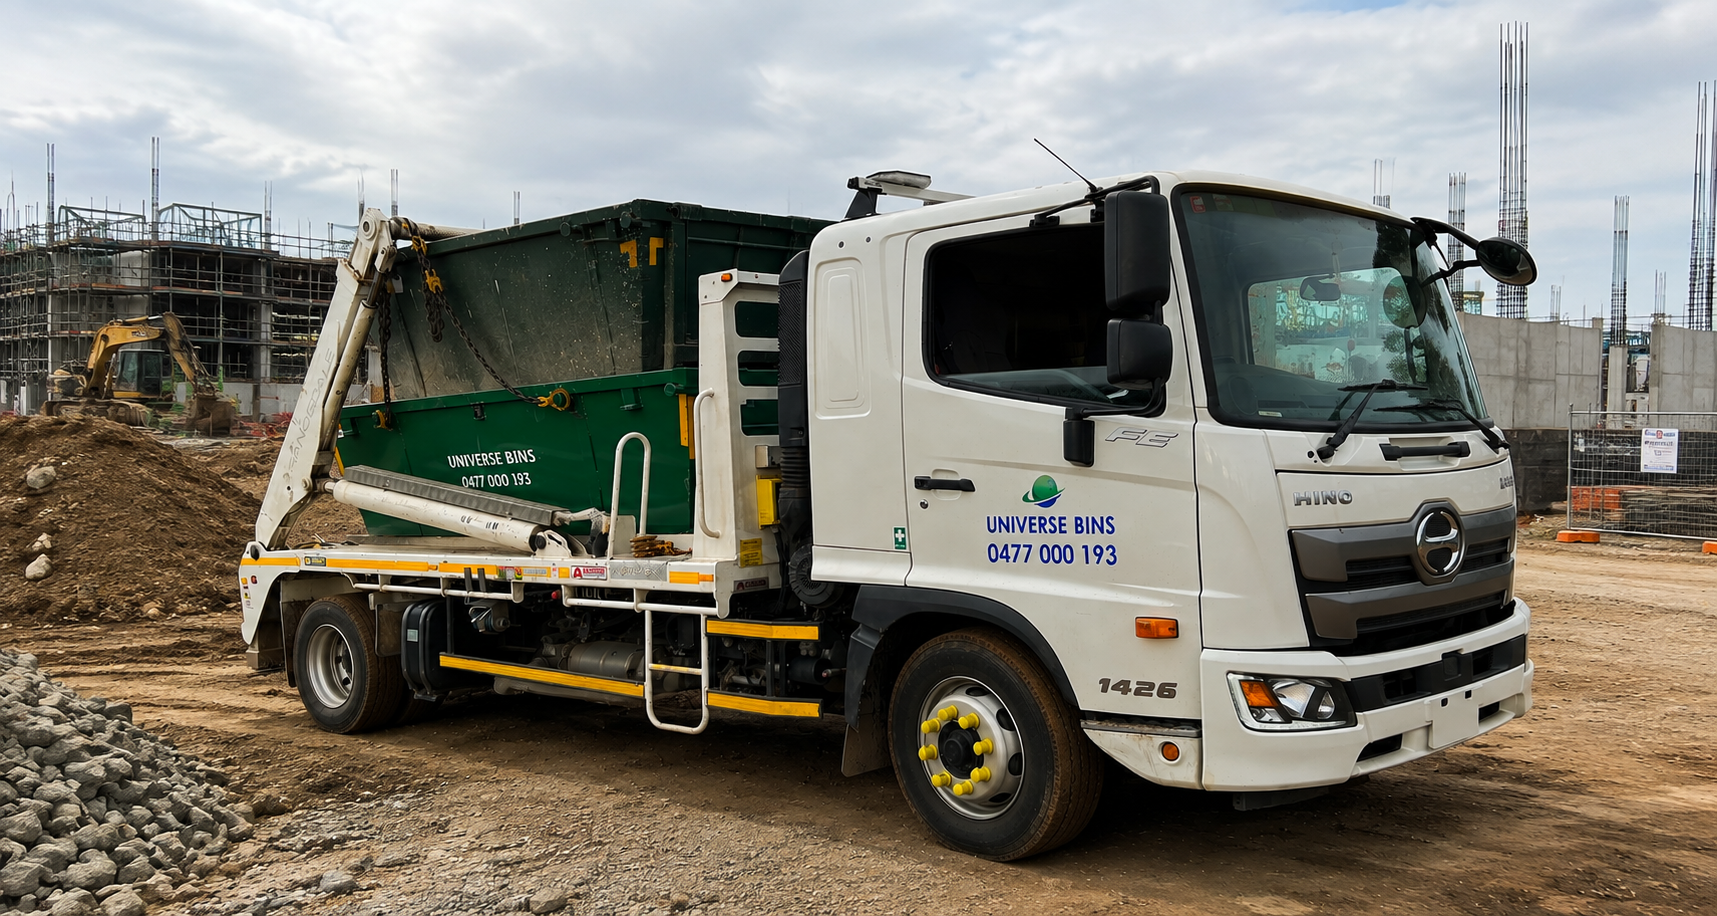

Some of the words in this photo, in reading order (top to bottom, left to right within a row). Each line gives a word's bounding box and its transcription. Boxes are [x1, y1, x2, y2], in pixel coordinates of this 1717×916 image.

[1105, 426, 1179, 448] FE
[447, 452, 503, 469] UNIVERSE
[504, 449, 536, 465] BINS
[461, 474, 484, 488] 0477
[487, 473, 509, 487] 000
[511, 472, 532, 486] 193
[1293, 490, 1353, 507] HINO
[986, 515, 1068, 535] UNIVERSE
[1074, 515, 1116, 535] BINS
[987, 543, 1033, 564] 0477
[1039, 544, 1075, 565] 000
[1081, 544, 1118, 566] 193
[1098, 677, 1178, 699] 1426
